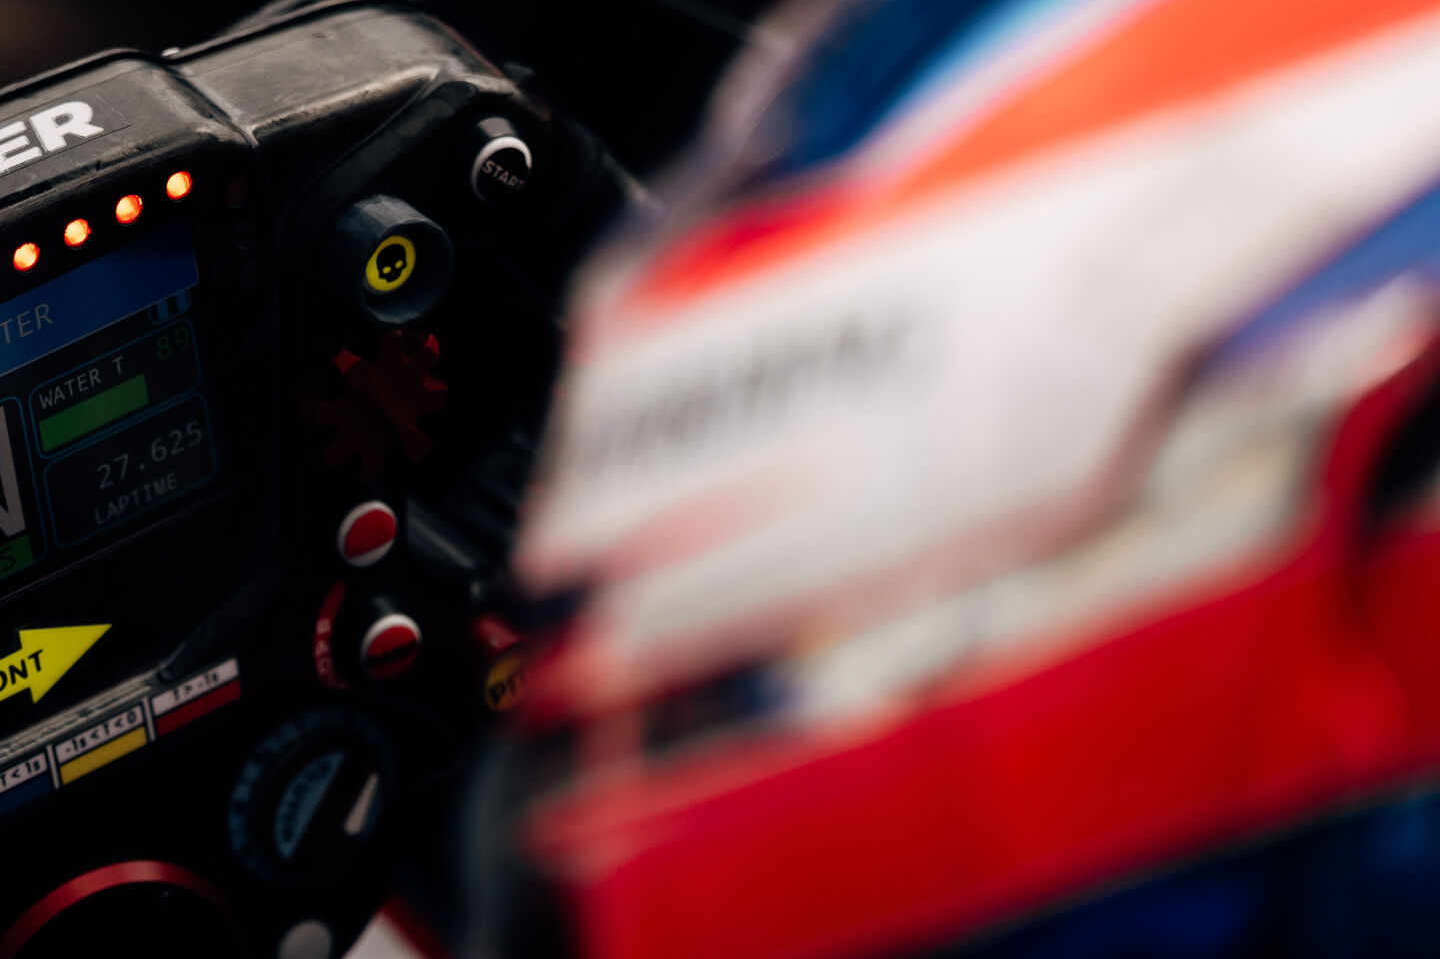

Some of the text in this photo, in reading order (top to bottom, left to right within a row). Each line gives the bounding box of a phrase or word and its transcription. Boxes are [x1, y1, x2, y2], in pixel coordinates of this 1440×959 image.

[38, 356, 125, 410] WATER T
[96, 420, 204, 490] 27.625
[93, 471, 180, 527] LAPTIME
[25, 759, 41, 775] 1s
